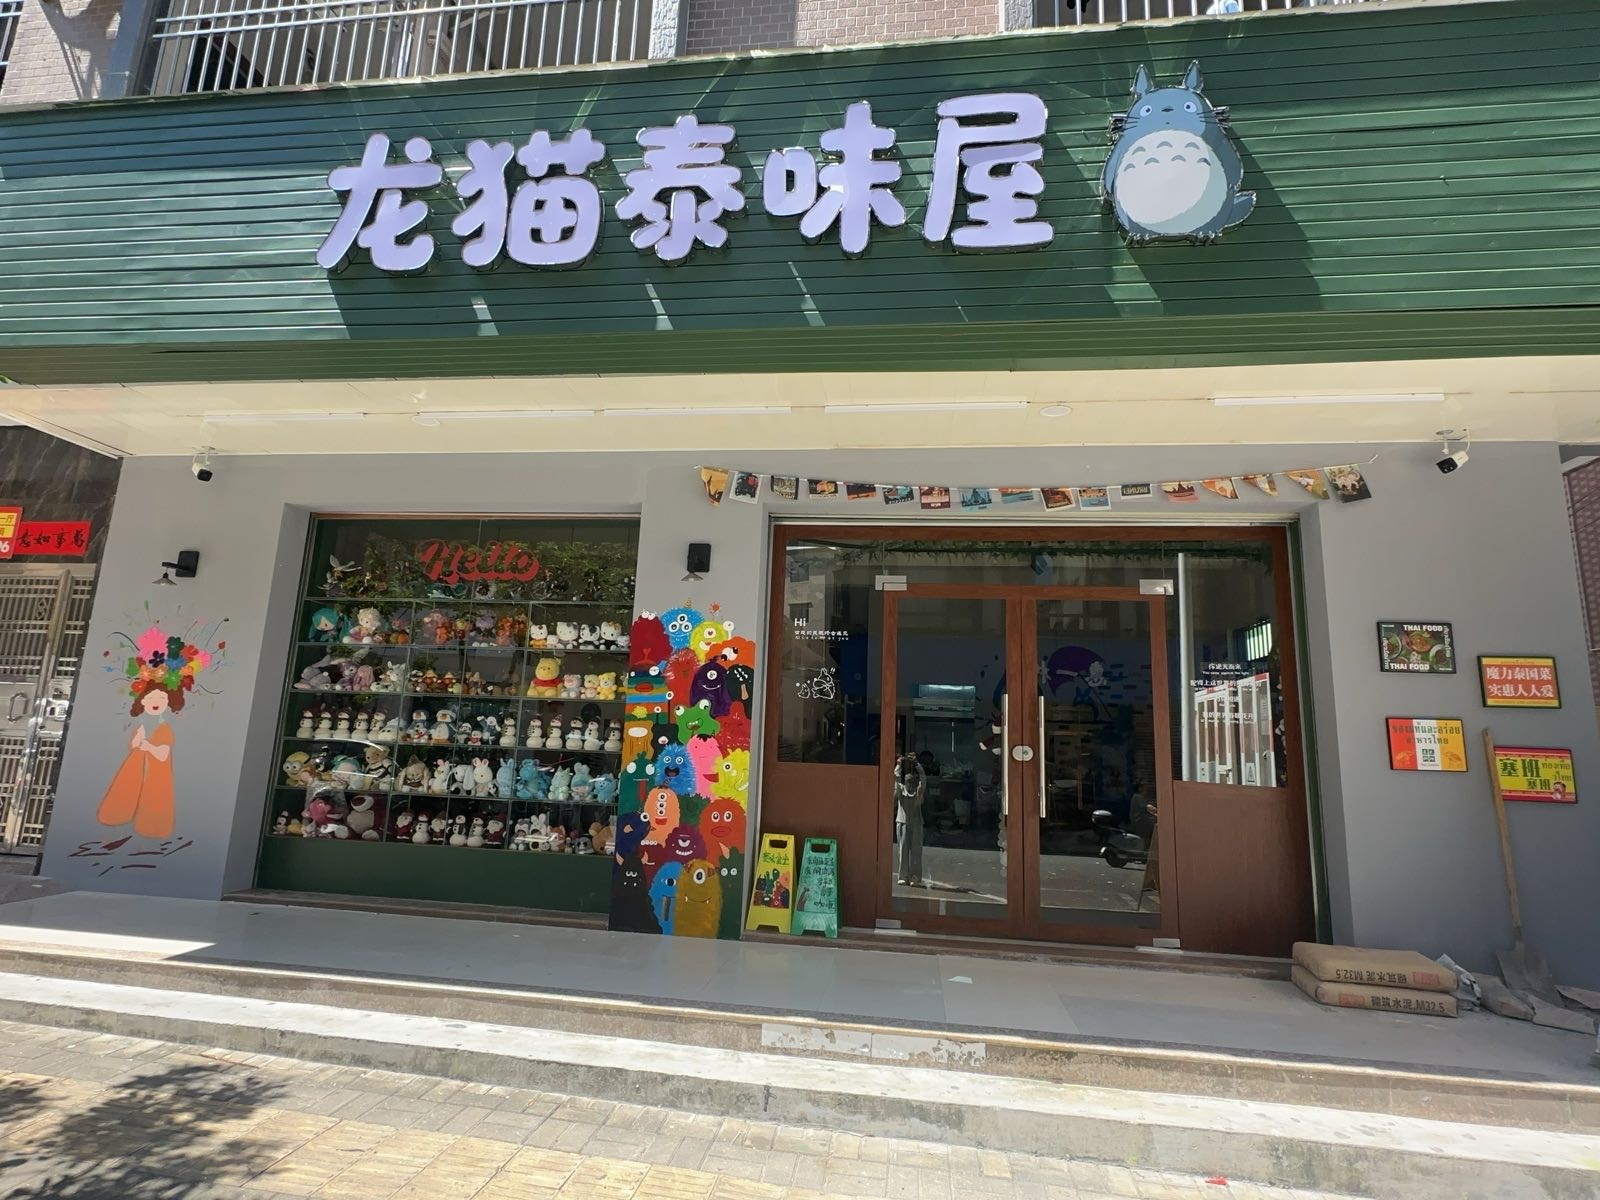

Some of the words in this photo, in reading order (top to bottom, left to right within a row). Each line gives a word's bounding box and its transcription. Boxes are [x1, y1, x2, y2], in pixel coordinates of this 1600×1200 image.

[316, 93, 1056, 272] 龙猫泰味屋
[416, 539, 541, 584] Hello
[794, 617, 806, 627] Hi
[1486, 665, 1552, 681] 魔力泰国菜
[1488, 683, 1554, 698] 实惠人人爱
